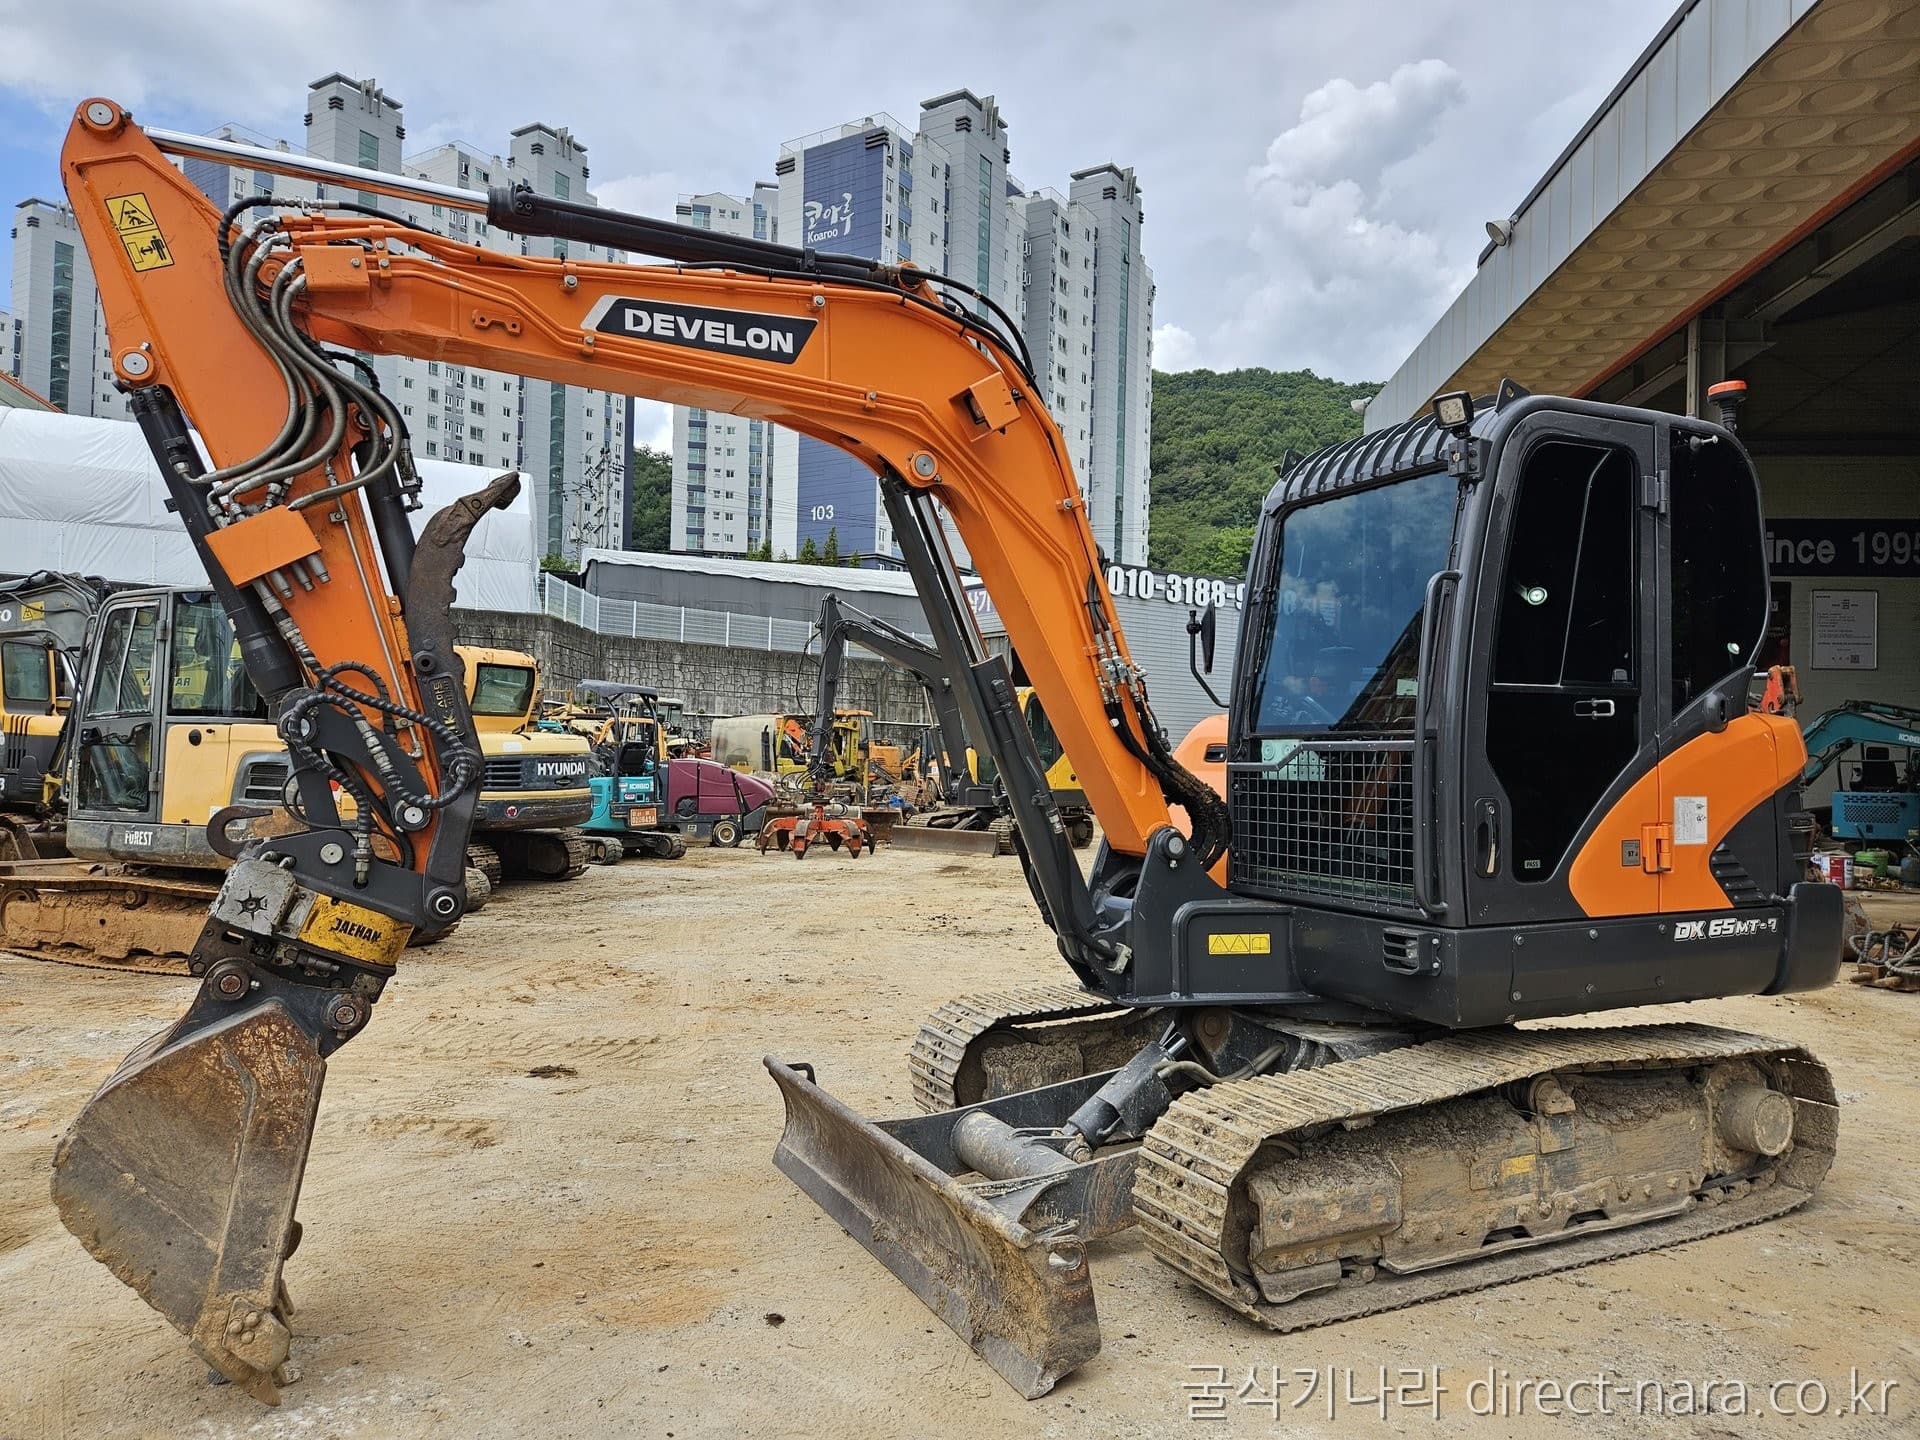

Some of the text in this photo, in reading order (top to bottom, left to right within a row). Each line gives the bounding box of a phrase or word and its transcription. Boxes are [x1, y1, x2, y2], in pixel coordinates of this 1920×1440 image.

[807, 228, 839, 244] Koaroo
[624, 308, 794, 353] DEVELON
[810, 504, 834, 521] 103
[1766, 531, 1836, 564] ince
[537, 761, 586, 776] HYUNDAI
[328, 917, 382, 944] JAEHAN
